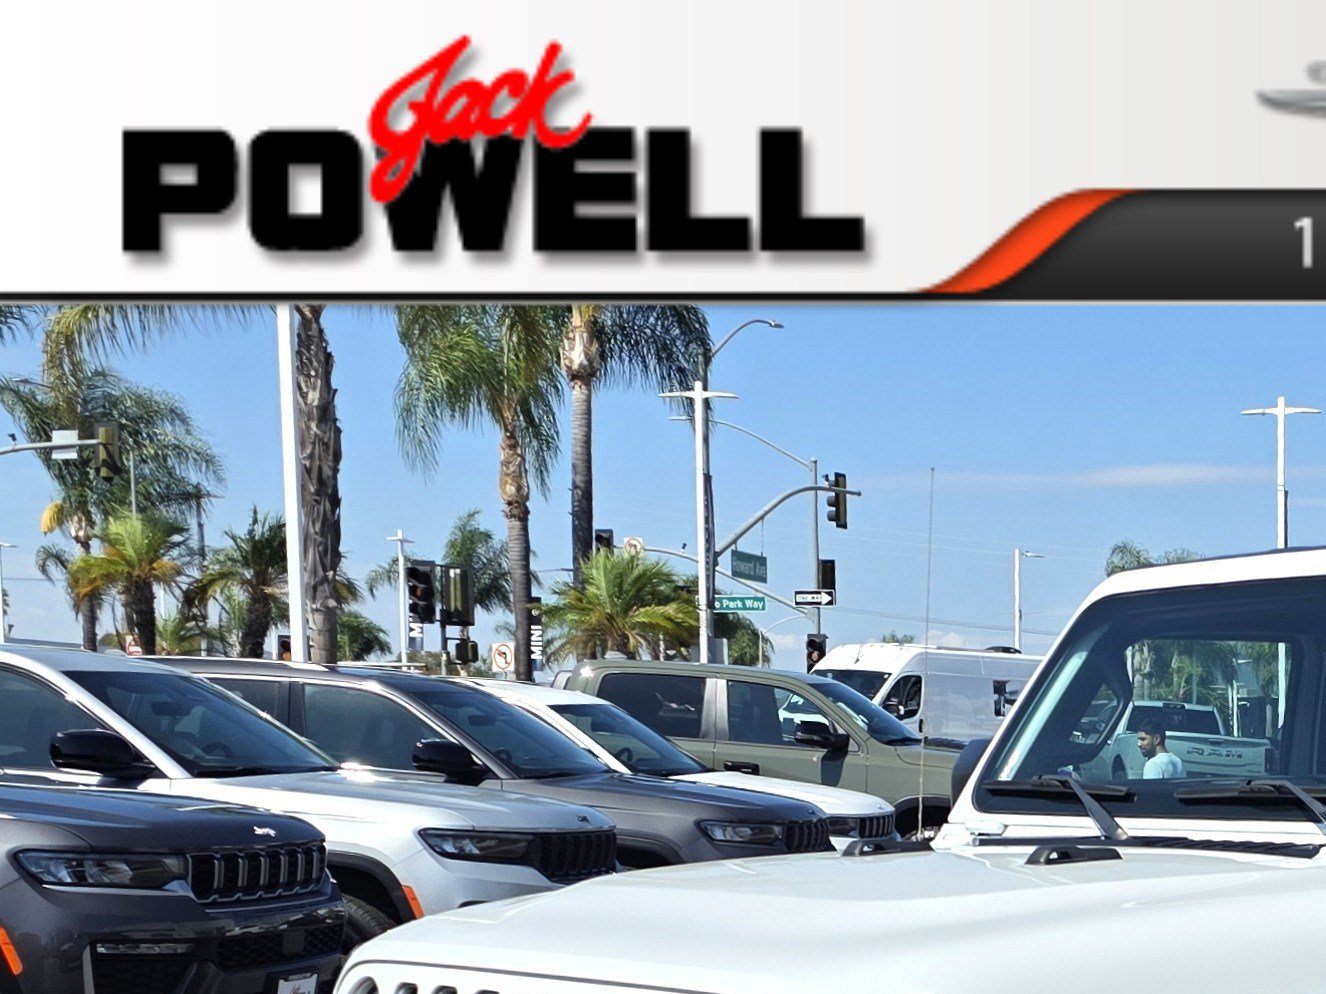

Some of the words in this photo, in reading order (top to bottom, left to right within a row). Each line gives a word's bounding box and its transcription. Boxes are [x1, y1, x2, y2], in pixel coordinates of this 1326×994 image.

[722, 598, 743, 609] Park
[744, 599, 764, 610] Way
[530, 625, 543, 660] MINI
